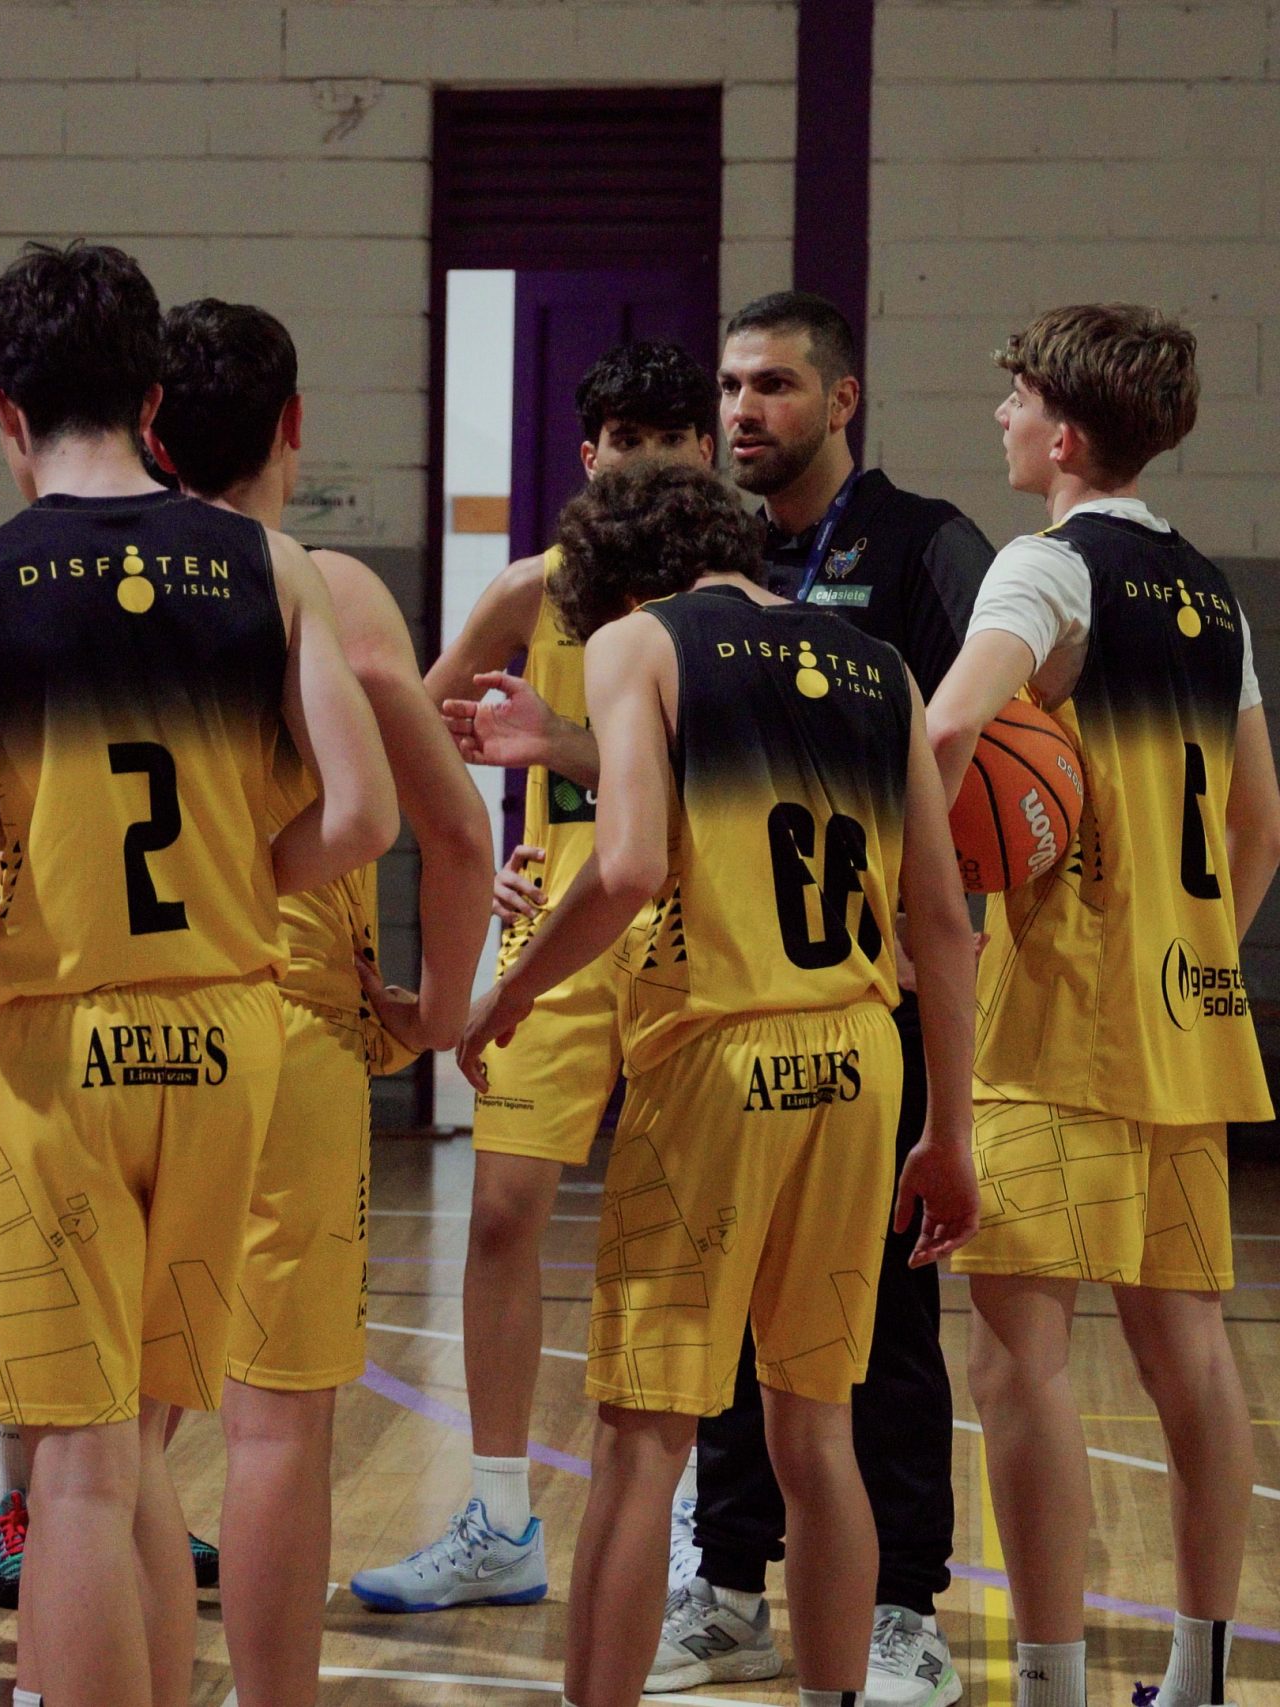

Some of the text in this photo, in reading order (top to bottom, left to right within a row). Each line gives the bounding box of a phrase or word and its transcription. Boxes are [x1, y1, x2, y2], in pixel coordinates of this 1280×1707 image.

[164, 583, 231, 599] 7 ISLAS
[815, 589, 866, 602] cajasiete
[835, 677, 884, 701] 7 ISLAS
[107, 741, 191, 937] 2
[1019, 788, 1058, 883] ilson
[81, 1025, 229, 1088] APELES
[128, 1068, 193, 1085] Limpzas
[743, 1048, 862, 1112] APELES
